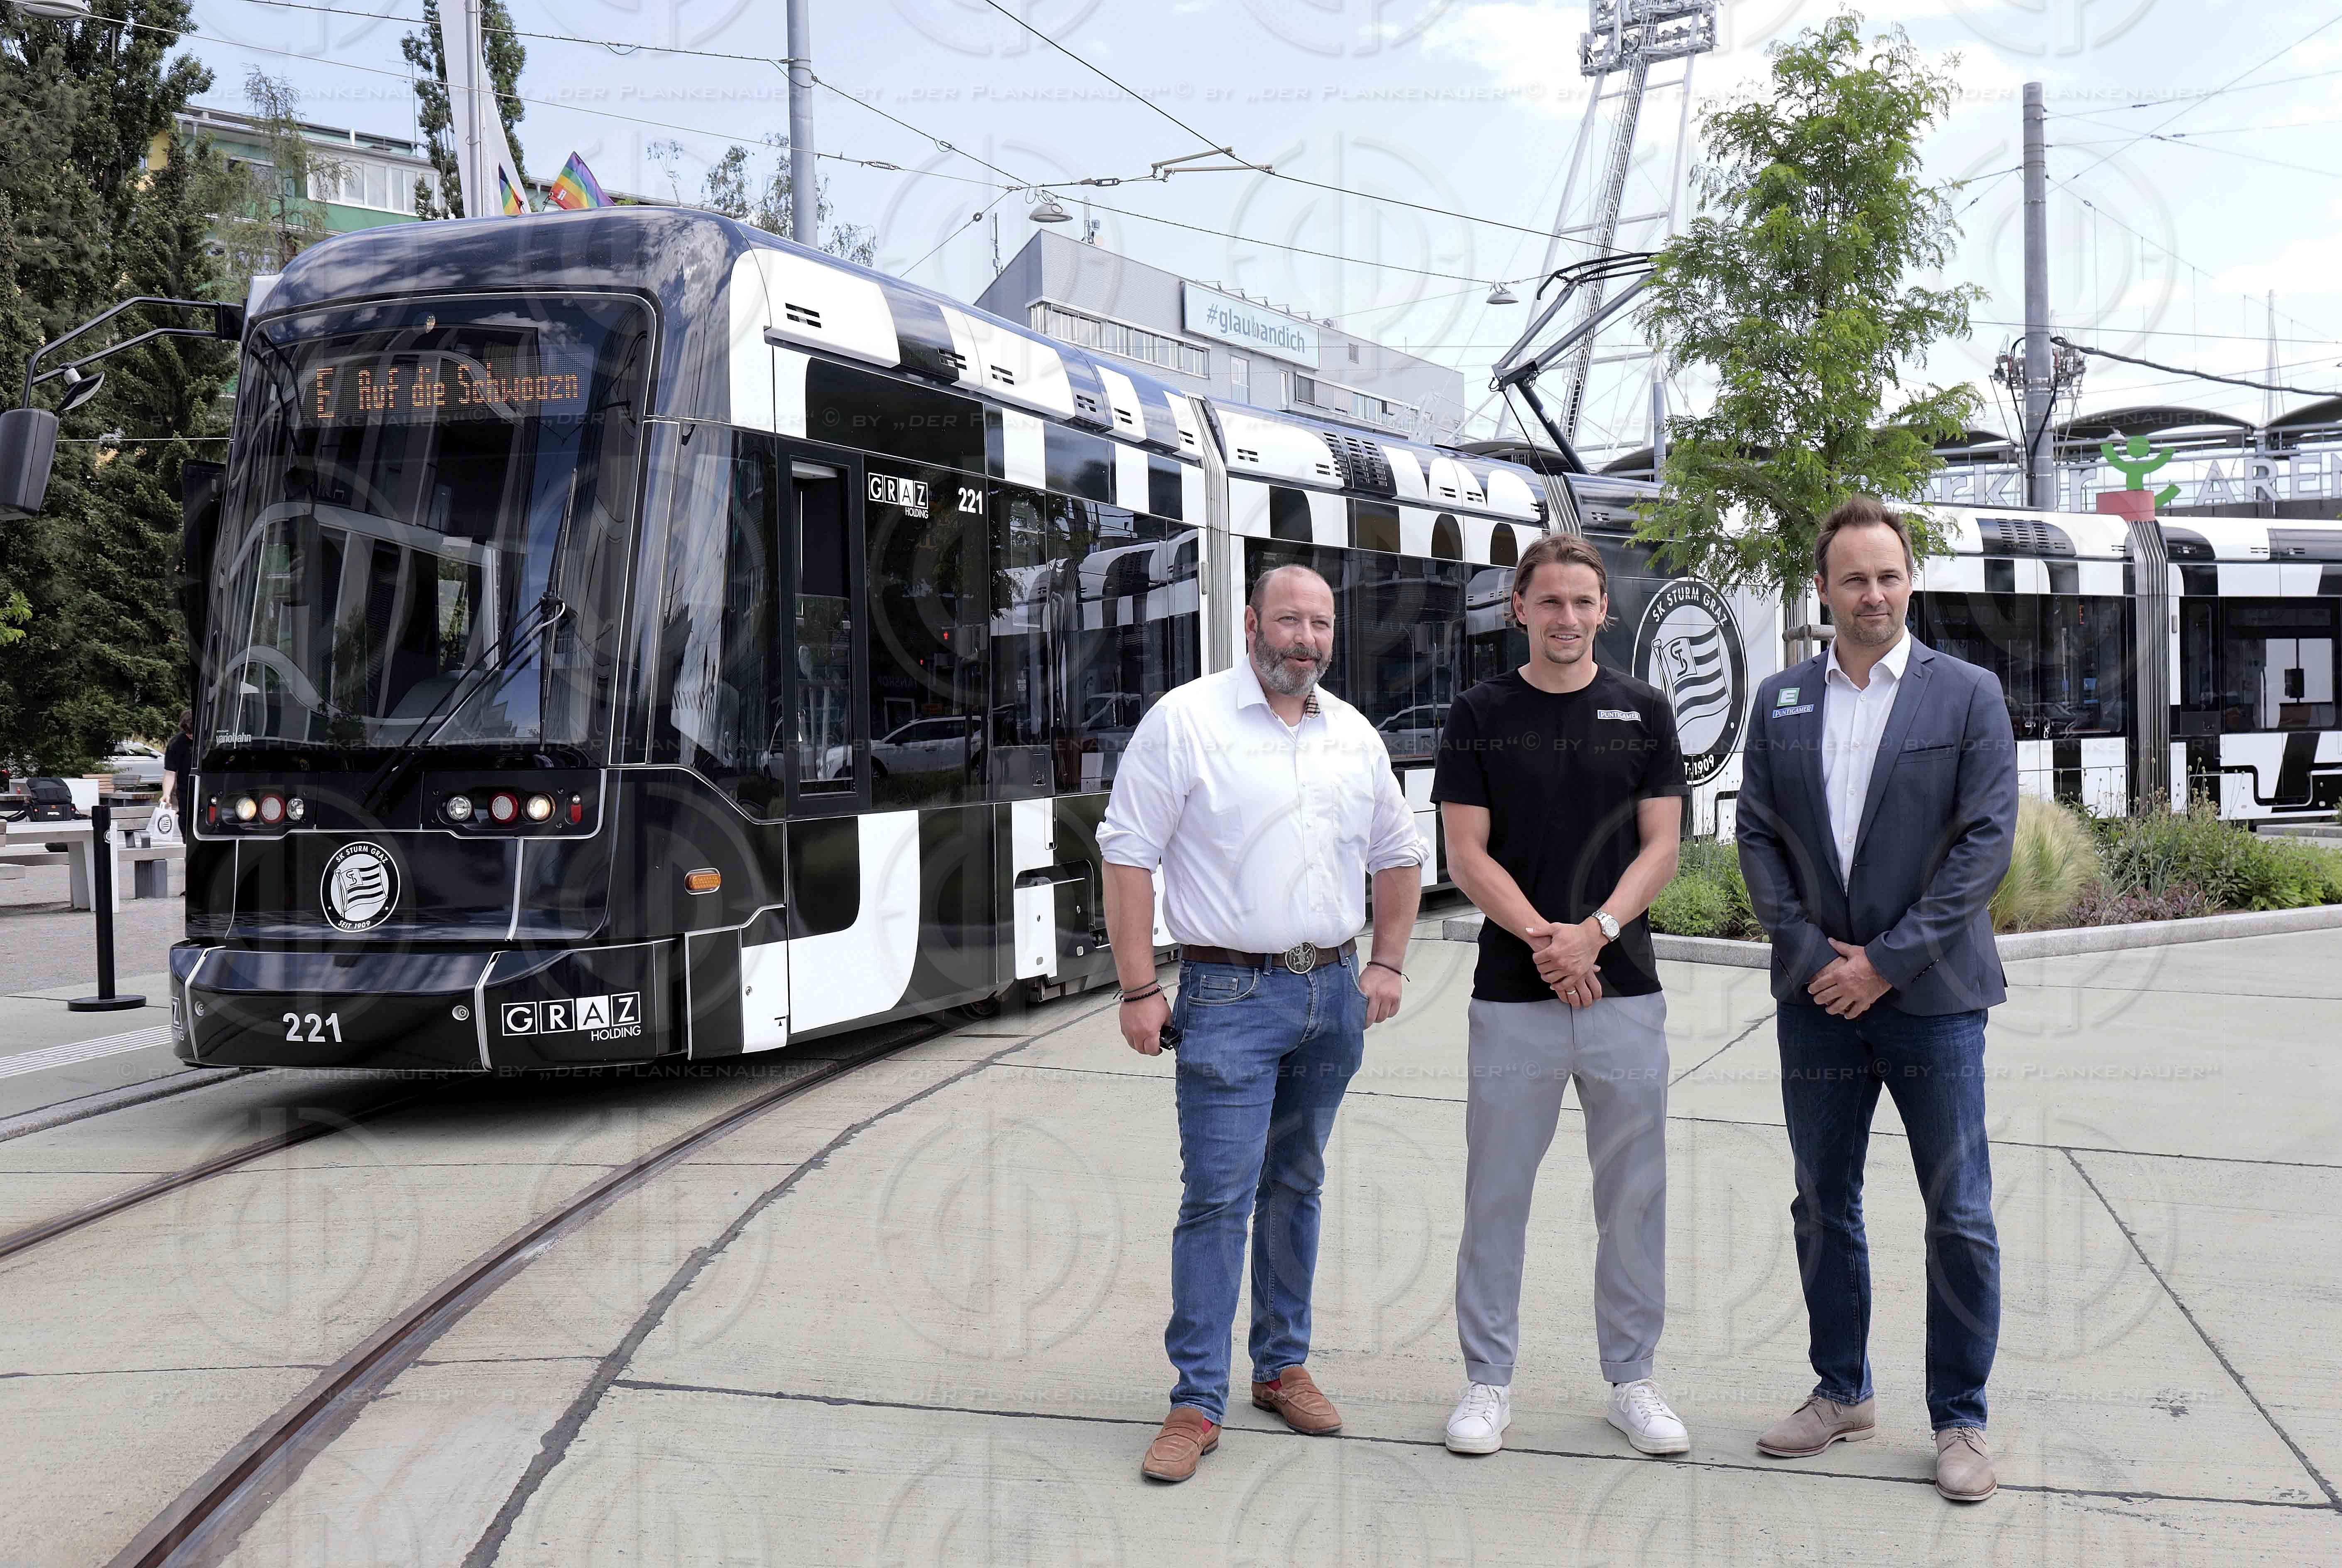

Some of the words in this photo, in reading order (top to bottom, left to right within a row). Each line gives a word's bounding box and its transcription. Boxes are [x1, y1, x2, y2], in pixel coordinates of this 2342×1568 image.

[316, 368, 335, 418] E
[358, 367, 399, 409] Auf
[412, 366, 446, 406] die
[870, 477, 926, 506] GRAZ
[2194, 452, 2342, 506] ARE
[905, 507, 929, 519] HOLDING
[958, 488, 983, 514] 221
[1653, 601, 1666, 622] SK
[1667, 587, 1700, 607] STURM
[1703, 593, 1728, 627] GRAZ
[1775, 706, 1811, 717] PUNTIGAMER
[1694, 755, 1715, 776] 1909
[336, 853, 345, 863] SK
[345, 845, 368, 855] STURM
[370, 848, 388, 864] GRAZ
[338, 920, 352, 929] SEIT
[354, 920, 371, 929] 1909
[282, 1012, 342, 1042] 221
[506, 997, 635, 1032] GRAZ
[590, 1025, 642, 1041] HOLDING
